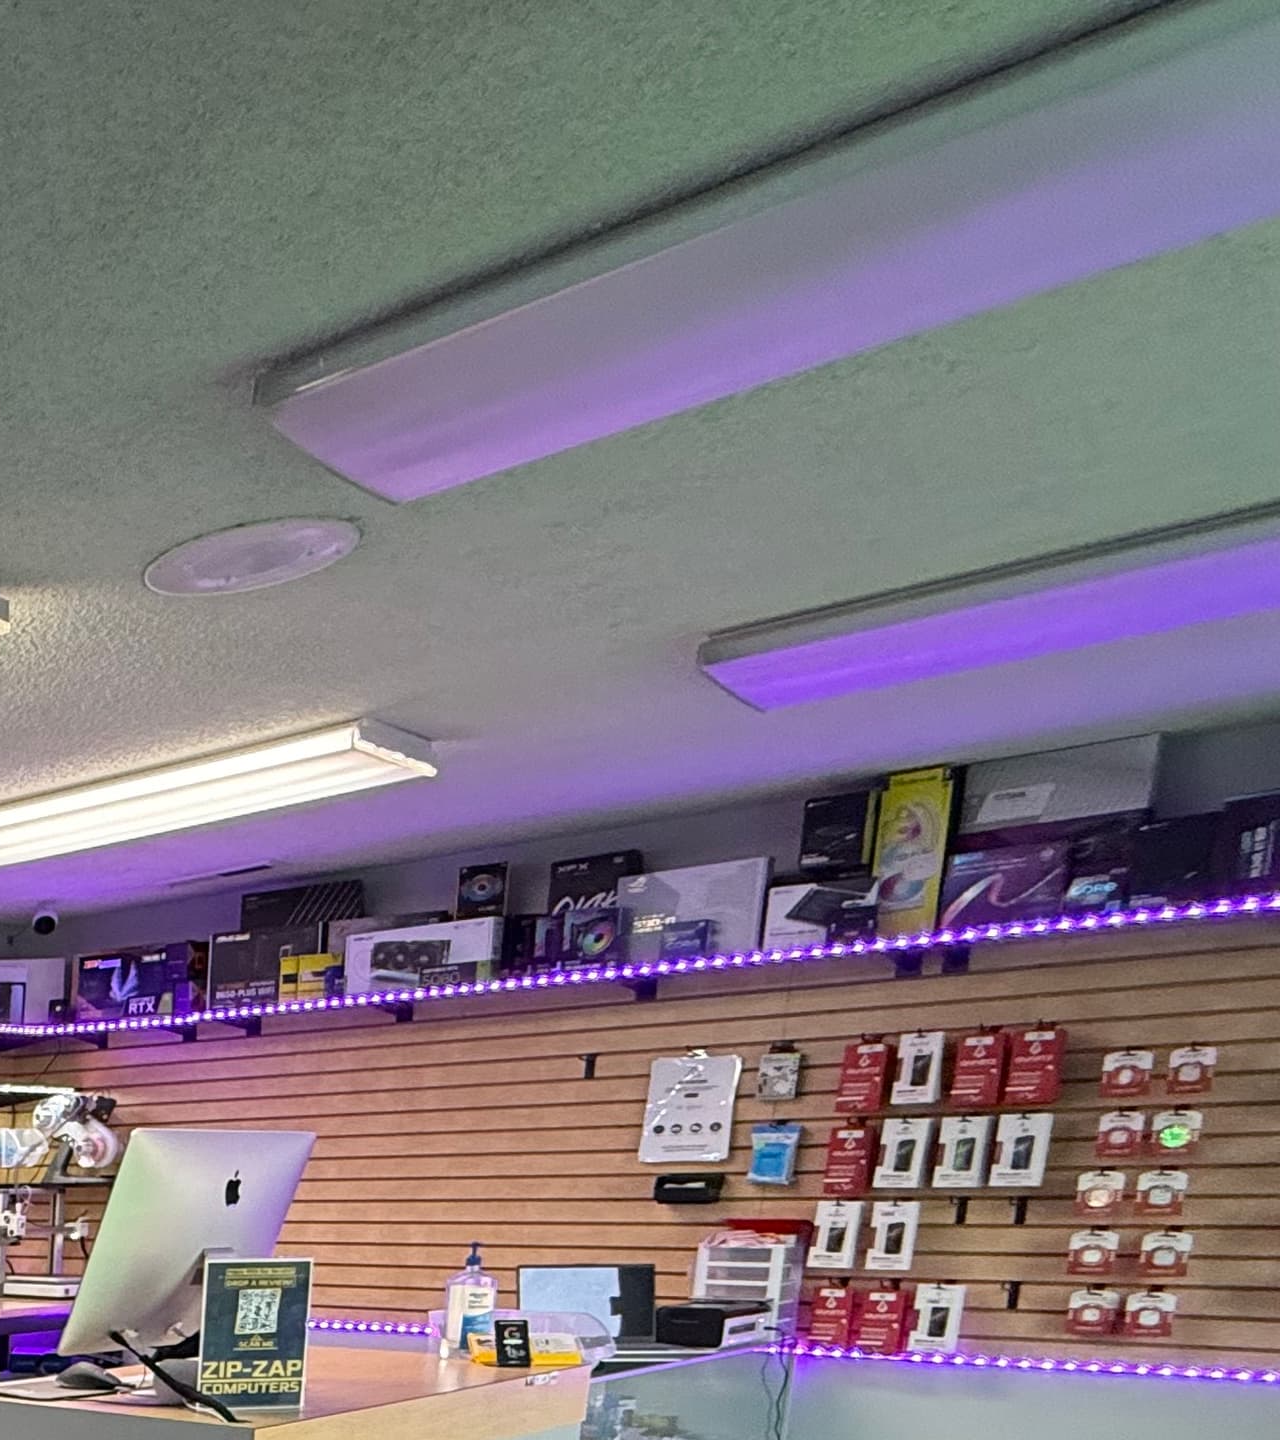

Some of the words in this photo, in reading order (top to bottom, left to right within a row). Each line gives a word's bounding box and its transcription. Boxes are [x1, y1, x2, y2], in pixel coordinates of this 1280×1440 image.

[127, 1001, 156, 1015] RTX
[201, 1359, 303, 1379] ZIP-ZAP
[201, 1381, 300, 1396] COMPUTERS
